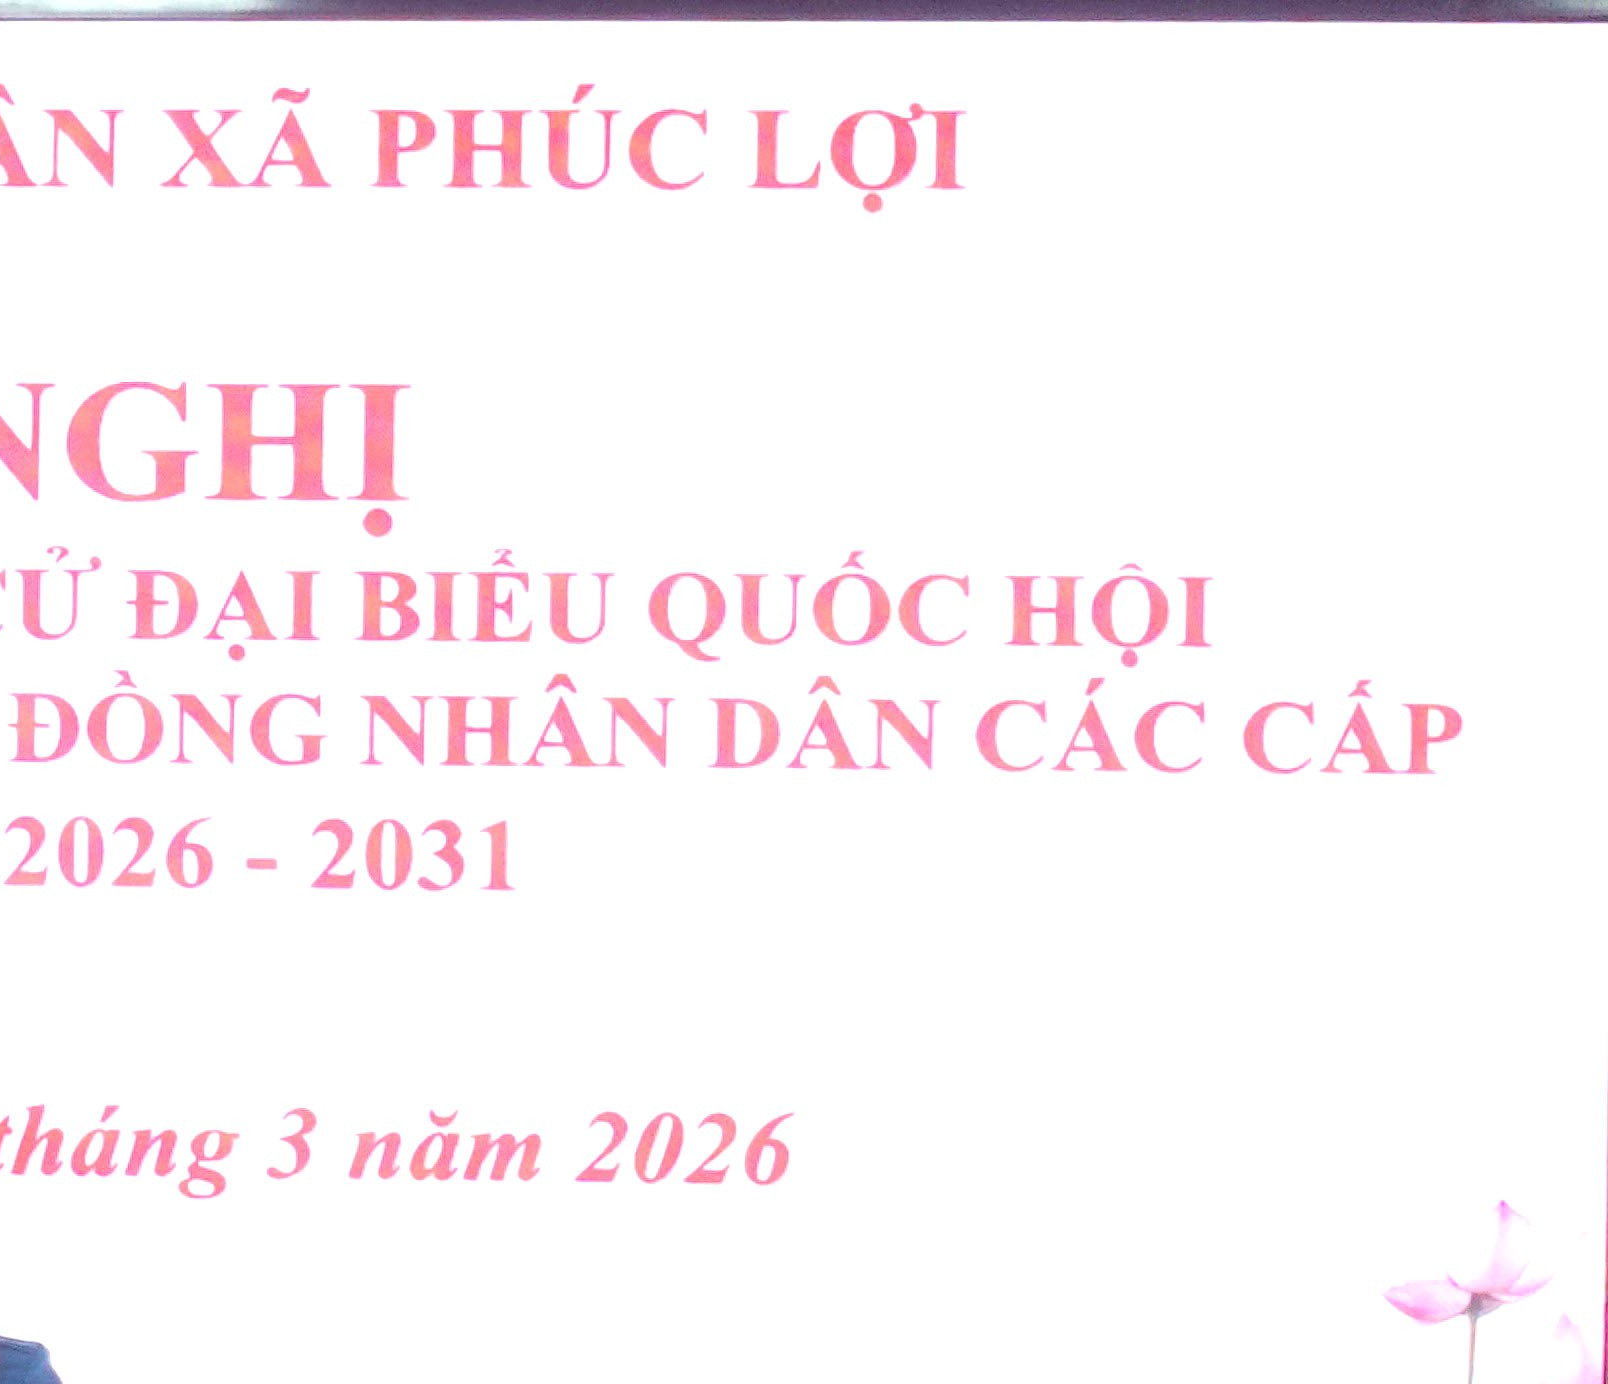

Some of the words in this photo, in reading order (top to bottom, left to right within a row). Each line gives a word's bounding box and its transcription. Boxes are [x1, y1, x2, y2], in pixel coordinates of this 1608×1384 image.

[161, 87, 331, 188] XÃ
[371, 83, 709, 191] PHÚC
[749, 103, 965, 213] LỢI
[127, 570, 320, 661] ĐẠI
[355, 549, 614, 644] BIỂU
[648, 551, 970, 662] QUỐC
[1006, 563, 1213, 668] HỘI
[10, 670, 327, 766] ĐỒNG
[360, 673, 676, 768] NHÂN
[709, 676, 939, 770] DÂN
[975, 677, 1205, 774] CÁC
[1242, 679, 1463, 775] CẤP
[3, 815, 214, 889] 2026
[247, 857, 277, 870] -
[311, 818, 516, 892] 2031
[265, 1107, 318, 1180] 3
[347, 1111, 543, 1182] năm
[575, 1111, 794, 1186] 2026
